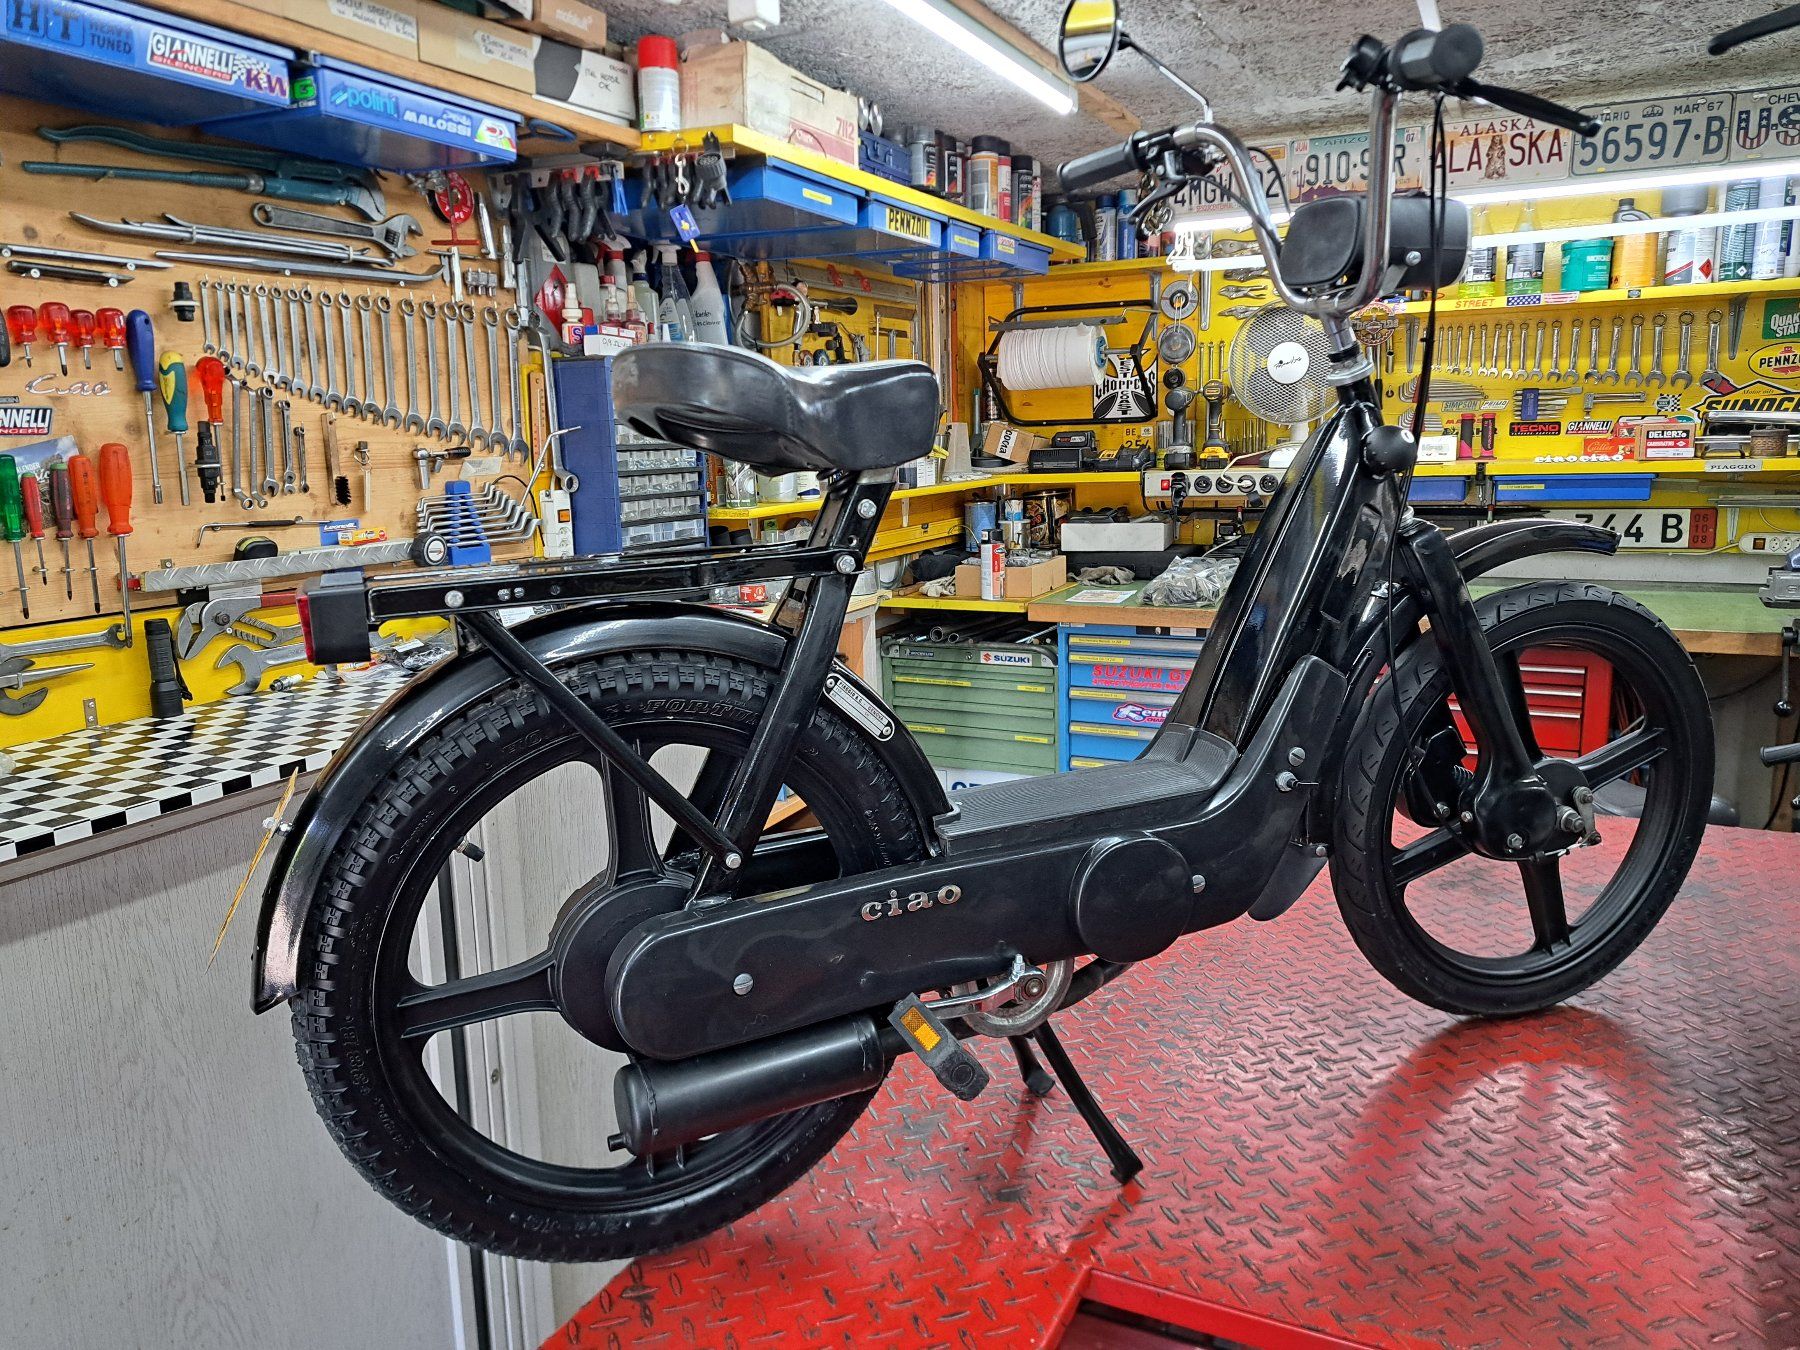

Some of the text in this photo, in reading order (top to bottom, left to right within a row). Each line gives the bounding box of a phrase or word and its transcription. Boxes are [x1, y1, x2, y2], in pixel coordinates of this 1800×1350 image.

[91, 32, 132, 54] TUNED
[152, 33, 233, 74] GIANNELLI
[347, 86, 396, 116] polini
[1593, 110, 1630, 123] TARIO
[1674, 102, 1700, 115] MAR
[403, 110, 471, 137] MALOSSI
[1460, 118, 1536, 137] ALASKA
[1323, 135, 1368, 147] ARIZO
[887, 207, 929, 239] PENNZOIL
[1770, 312, 1800, 331] QUAK
[1775, 322, 1800, 338] STAT
[1759, 353, 1800, 369] PENNZ
[25, 373, 112, 396] Ciao
[1445, 400, 1477, 409] SIMPSON
[0, 408, 51, 428] NNELLI
[1511, 424, 1560, 432] TECNO
[1567, 421, 1611, 431] GIANNELLI
[1661, 513, 1683, 543] B
[993, 654, 1030, 664] SUZUKI
[1092, 664, 1193, 682] SUZUKI GS
[645, 698, 758, 726] FORTU
[861, 884, 962, 922] ciao
